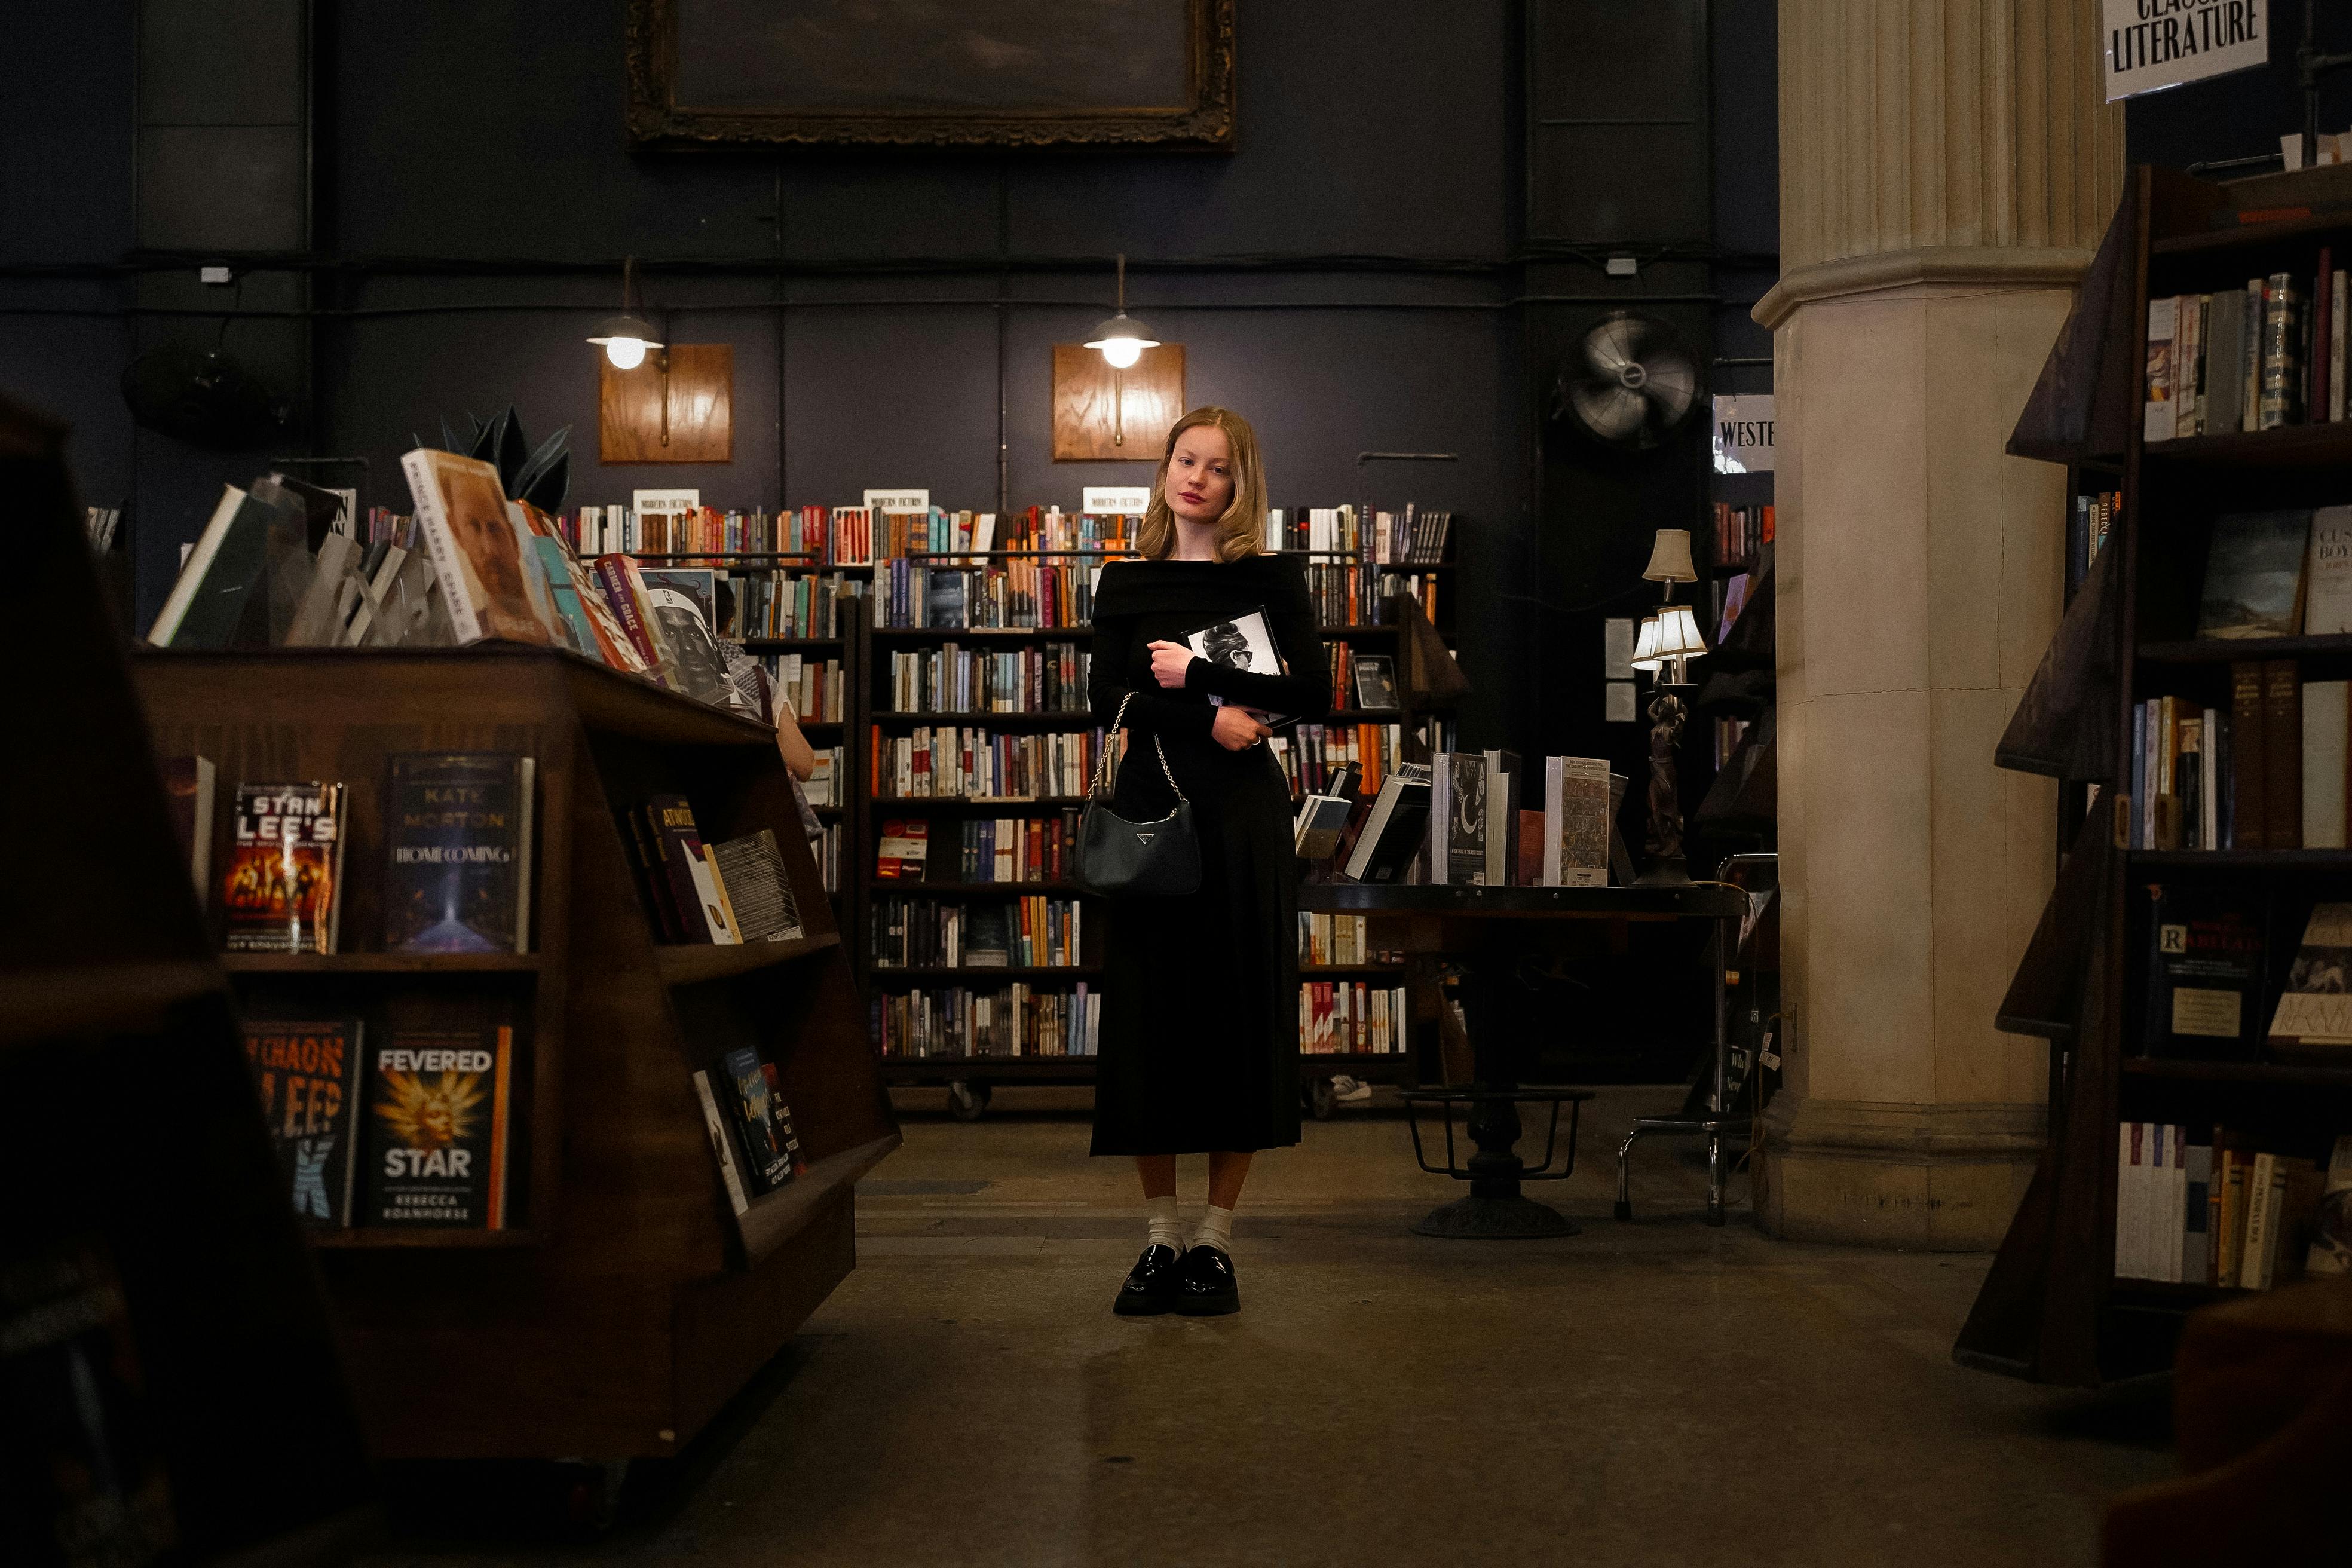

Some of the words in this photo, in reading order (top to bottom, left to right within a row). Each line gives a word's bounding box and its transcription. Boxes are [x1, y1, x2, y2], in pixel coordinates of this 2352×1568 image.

[2112, 0, 2258, 73] LITERATURE
[1720, 421, 1774, 448] WESTE
[620, 602, 639, 632] GRACE
[252, 795, 321, 816] STAN
[424, 788, 480, 804] KATE
[236, 814, 338, 842] LEE'S
[403, 811, 506, 828] MORTON
[396, 846, 510, 864] HOMECOMING
[376, 1049, 492, 1073] FEVERED
[382, 1147, 474, 1179] STAR
[394, 1194, 458, 1206] REBECCA
